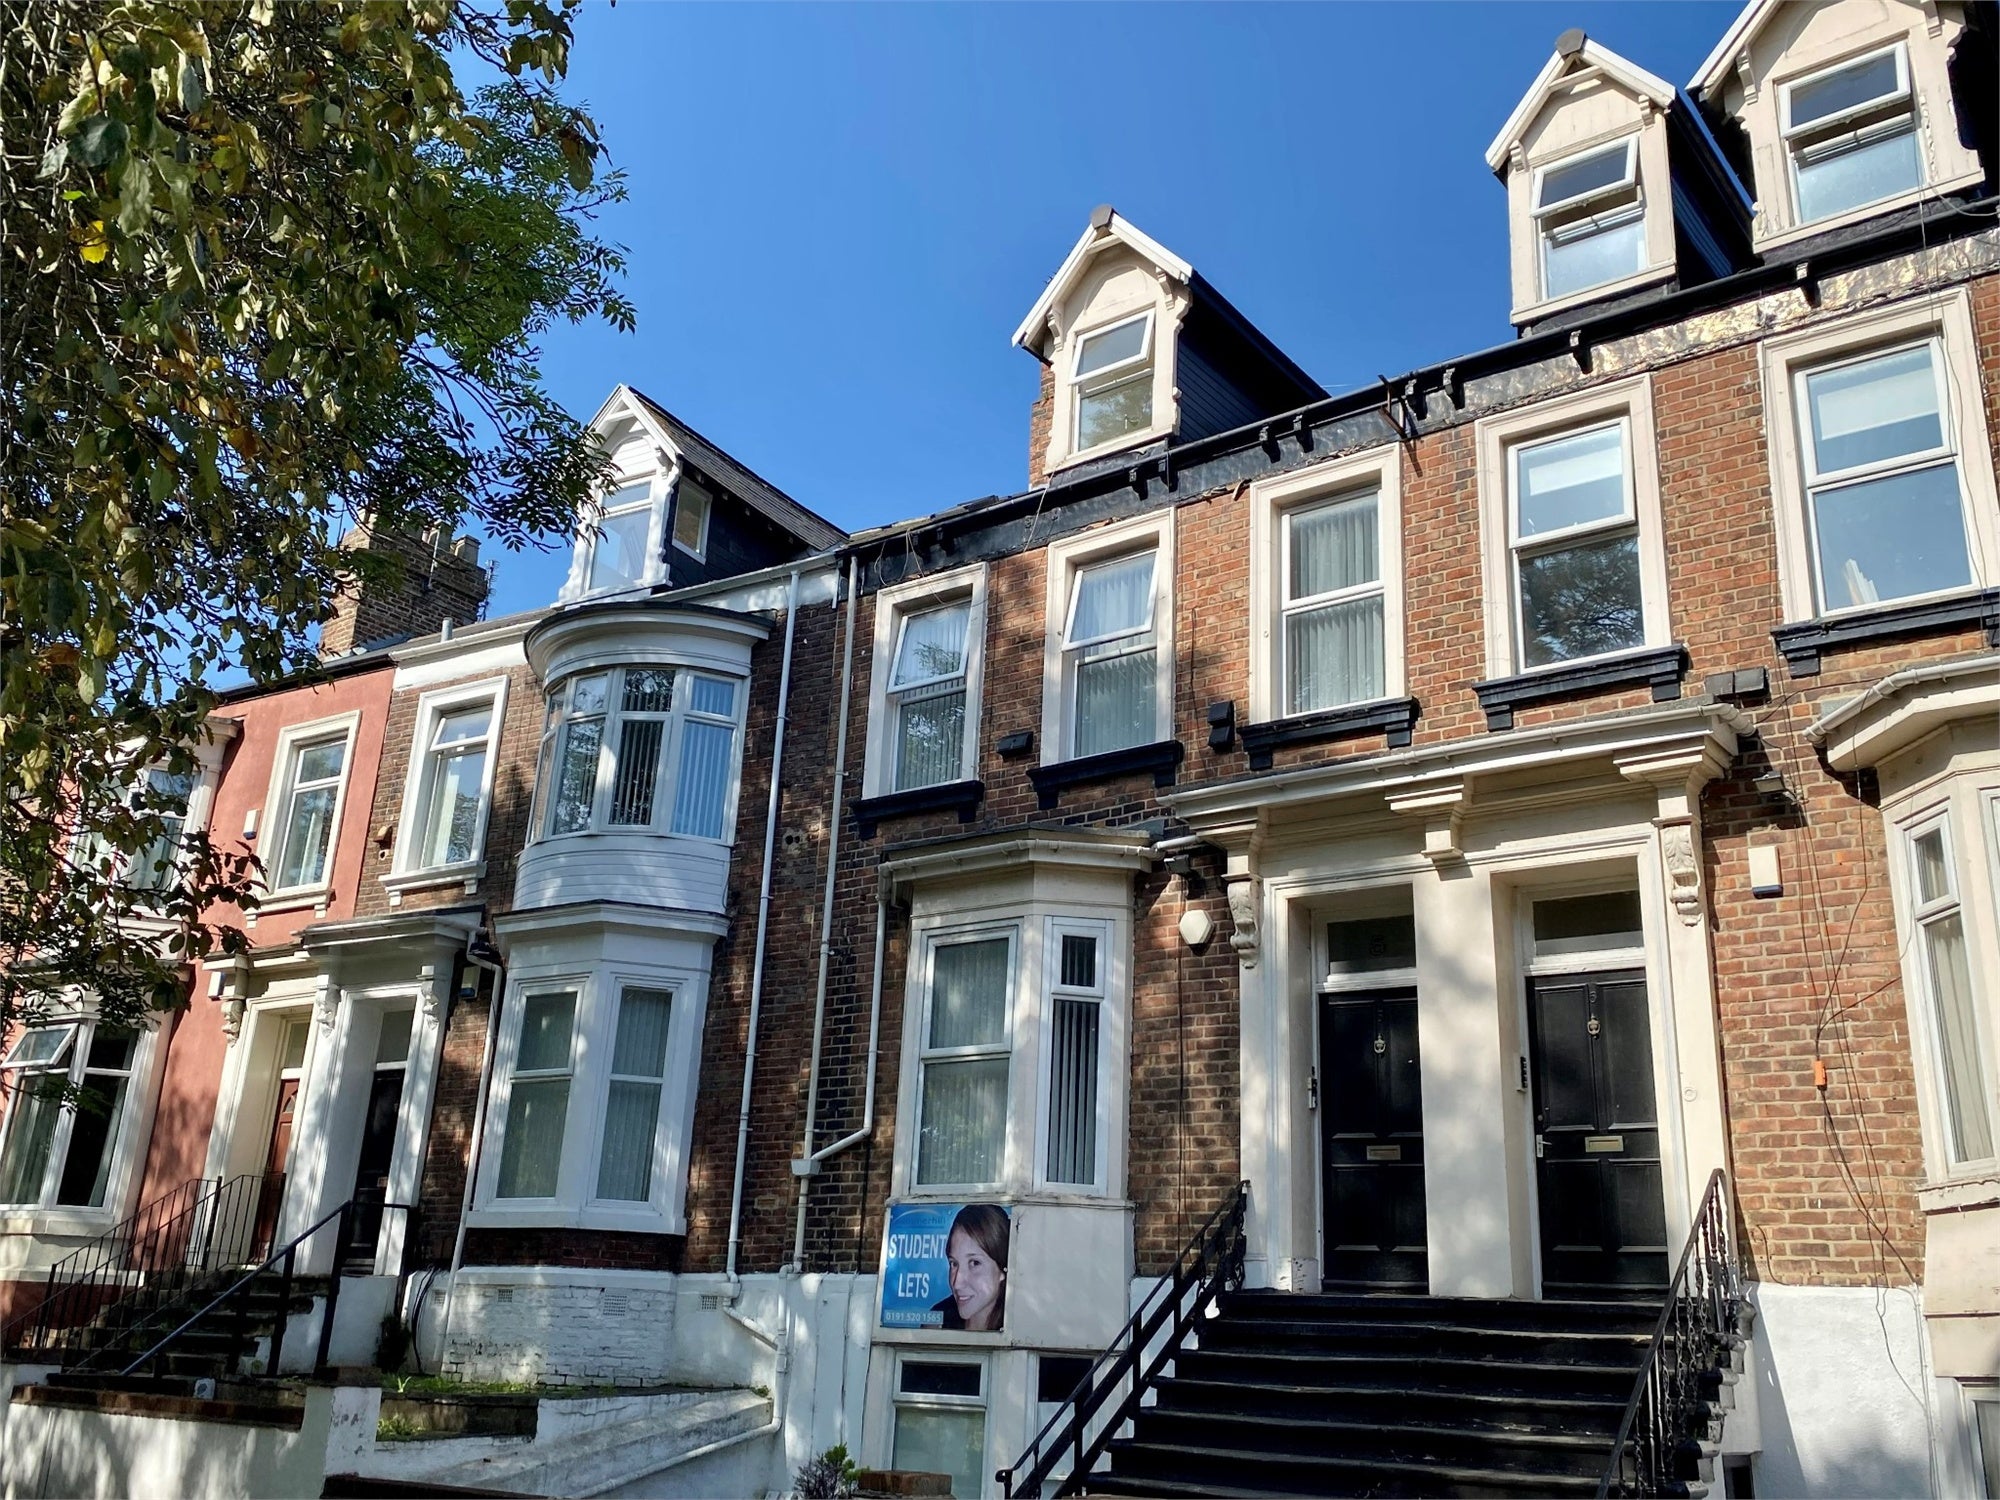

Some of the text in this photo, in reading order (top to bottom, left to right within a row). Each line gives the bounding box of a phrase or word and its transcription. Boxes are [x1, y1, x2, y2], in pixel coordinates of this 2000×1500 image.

[888, 1234, 948, 1259] STUDENT
[898, 1272, 930, 1298] LETS
[885, 1312, 904, 1321] 0191
[906, 1312, 921, 1322] 520
